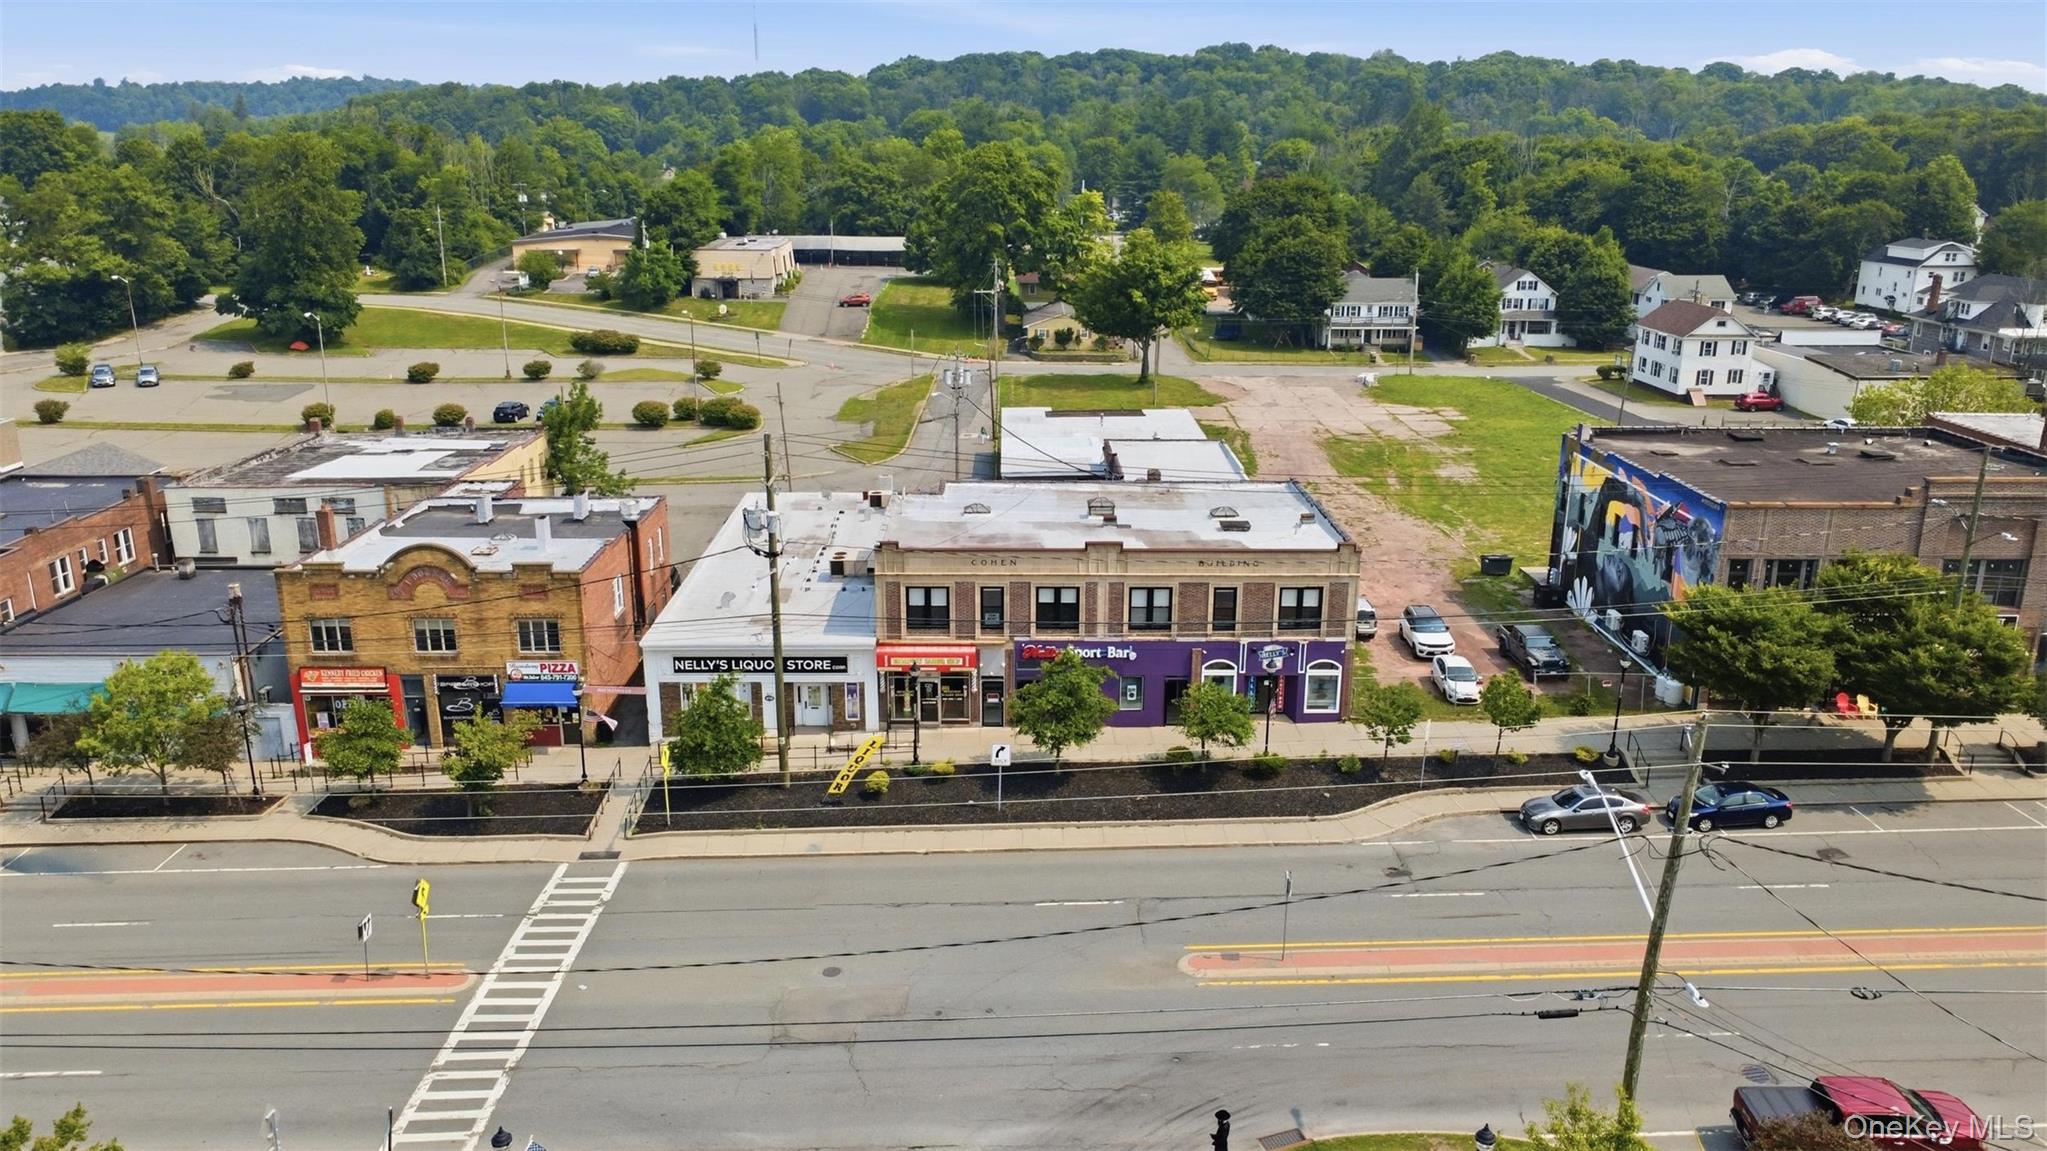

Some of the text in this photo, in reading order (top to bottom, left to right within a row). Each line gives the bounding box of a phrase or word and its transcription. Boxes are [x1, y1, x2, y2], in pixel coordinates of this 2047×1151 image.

[970, 559, 1016, 567] COHEN
[1107, 646, 1129, 659] Bar
[539, 663, 577, 673] PIZZA
[674, 660, 728, 671] NELLY'S
[731, 660, 776, 671] LIQUO
[786, 660, 831, 670] STORE
[832, 740, 877, 792] LIQUOR
